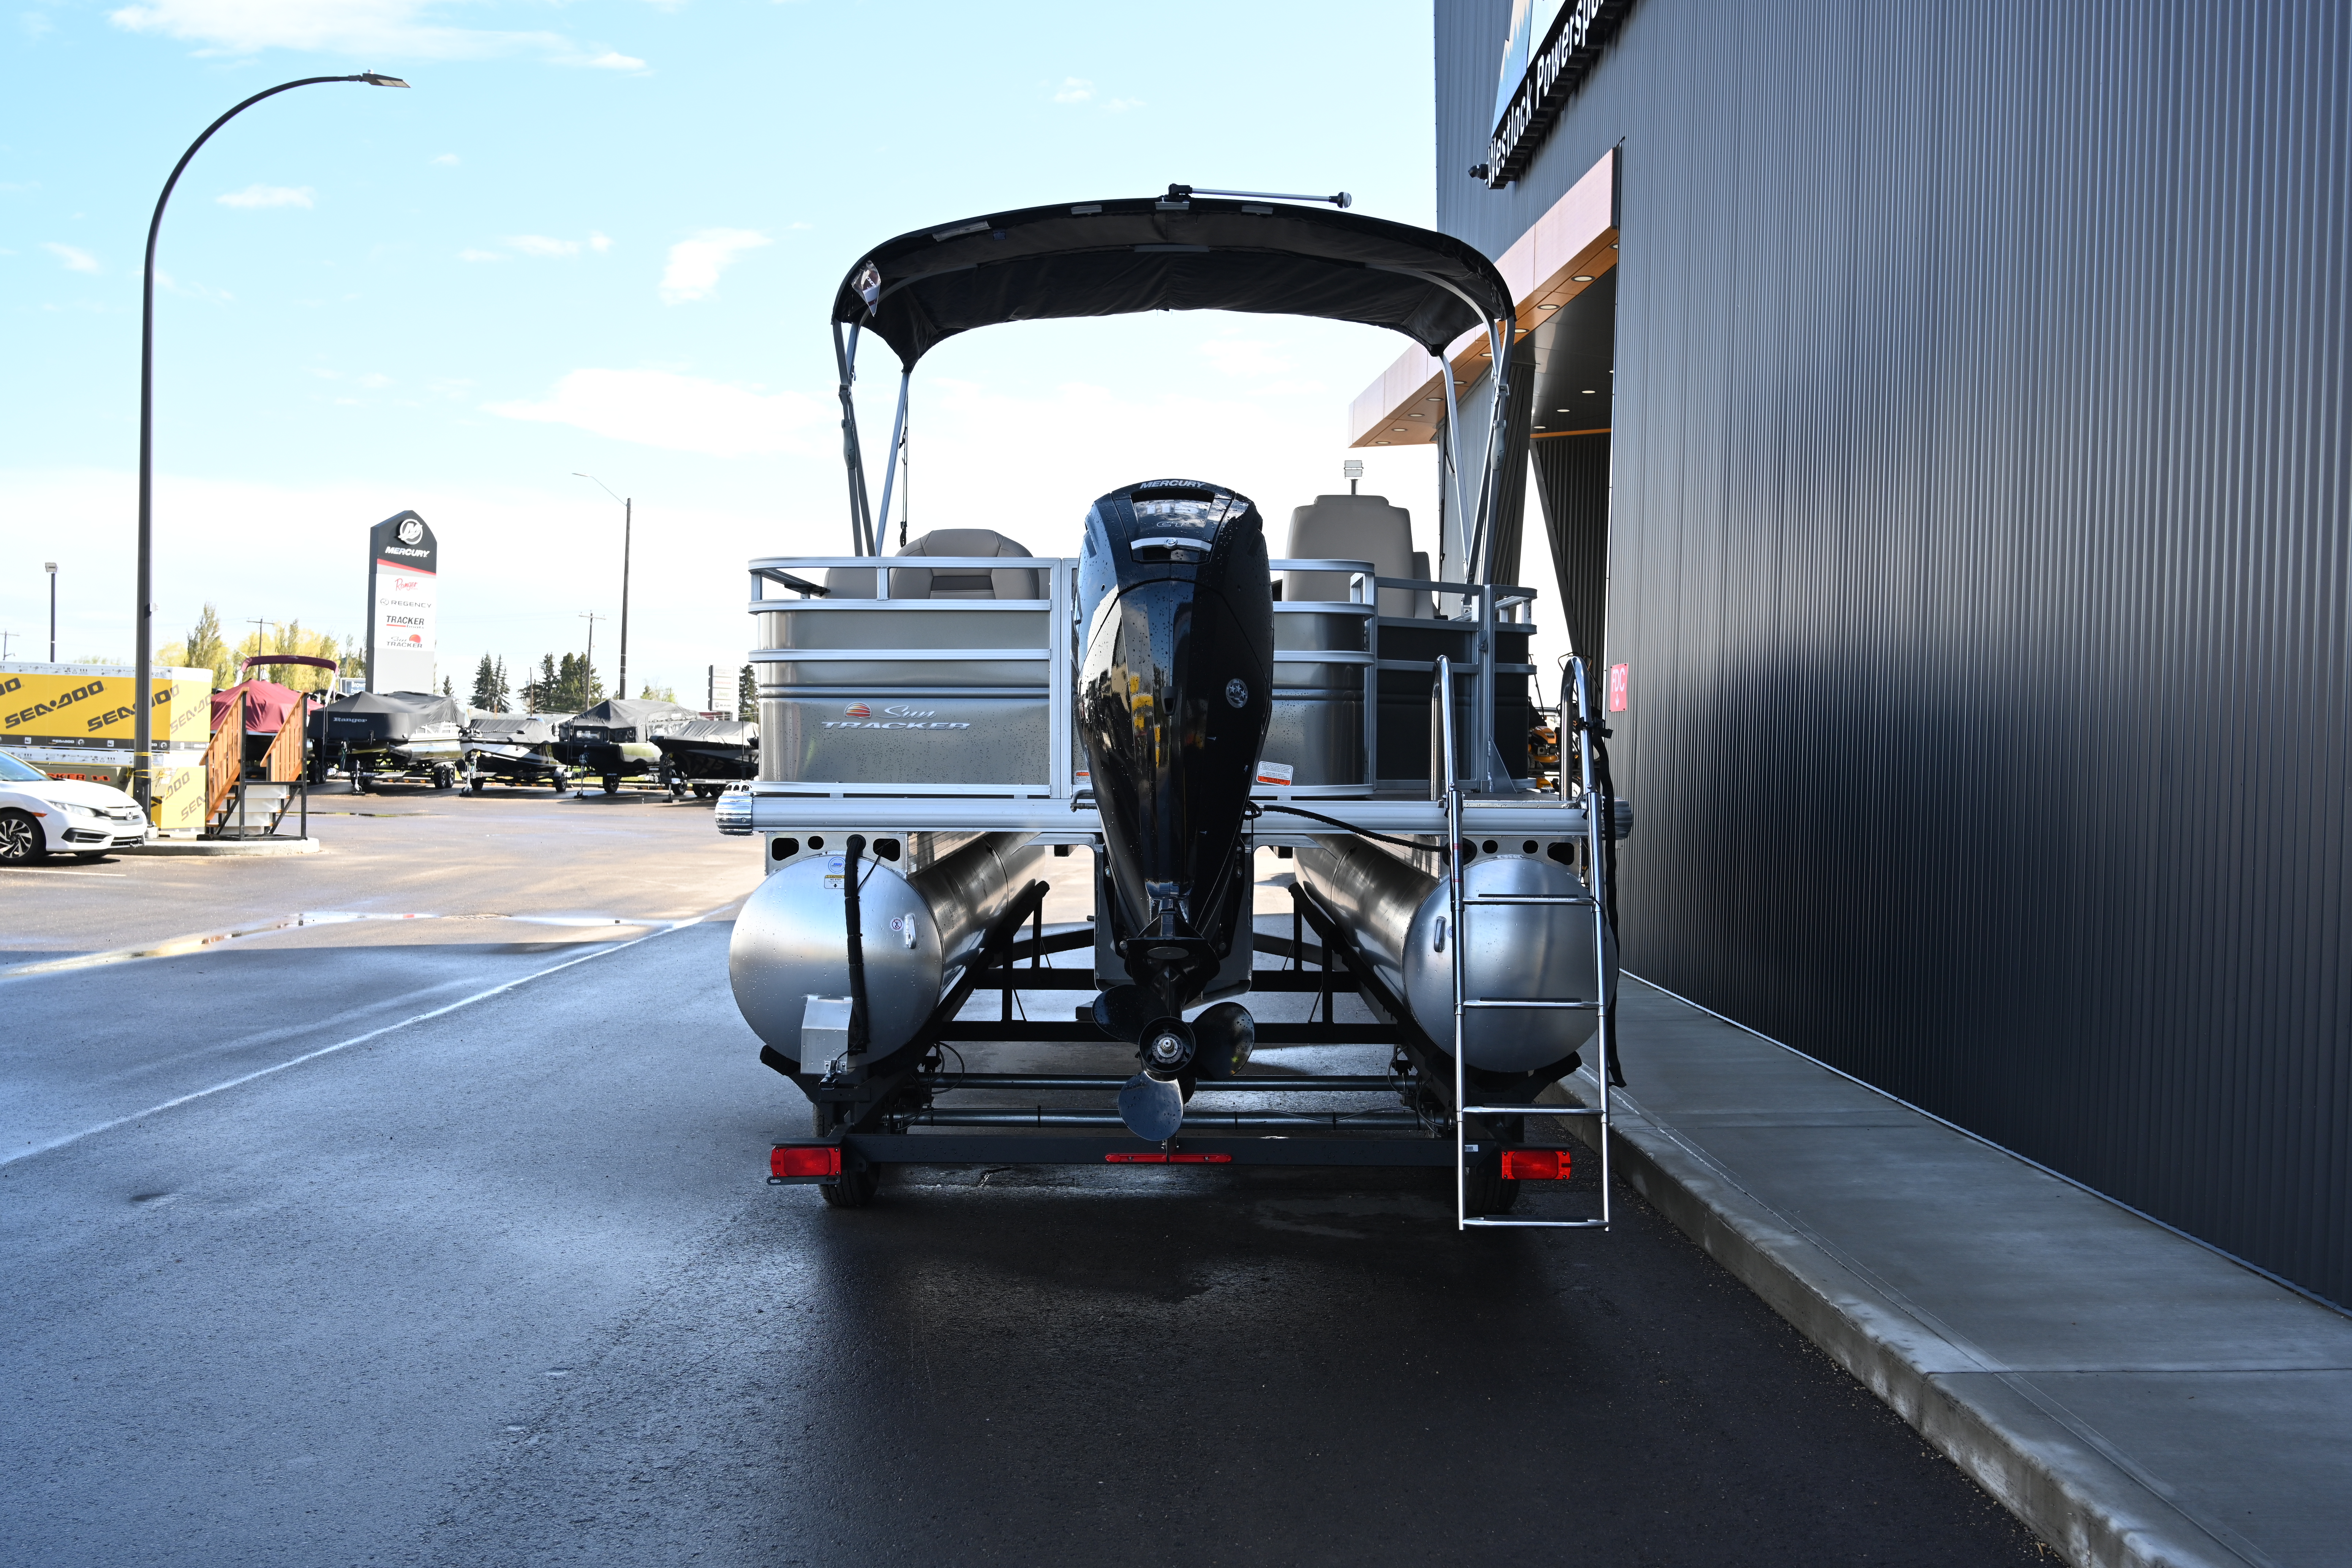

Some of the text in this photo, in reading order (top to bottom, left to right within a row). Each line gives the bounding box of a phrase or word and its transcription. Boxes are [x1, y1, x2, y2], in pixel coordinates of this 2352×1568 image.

[1487, 77, 1532, 189] Westlock
[1140, 480, 1206, 488] MERCURY
[1146, 503, 1199, 515] 115
[385, 546, 430, 557] MERCURY
[395, 578, 417, 591] Ranger
[386, 616, 424, 625] TRACKER
[1612, 667, 1625, 692] FDC
[875, 705, 937, 719] Sun
